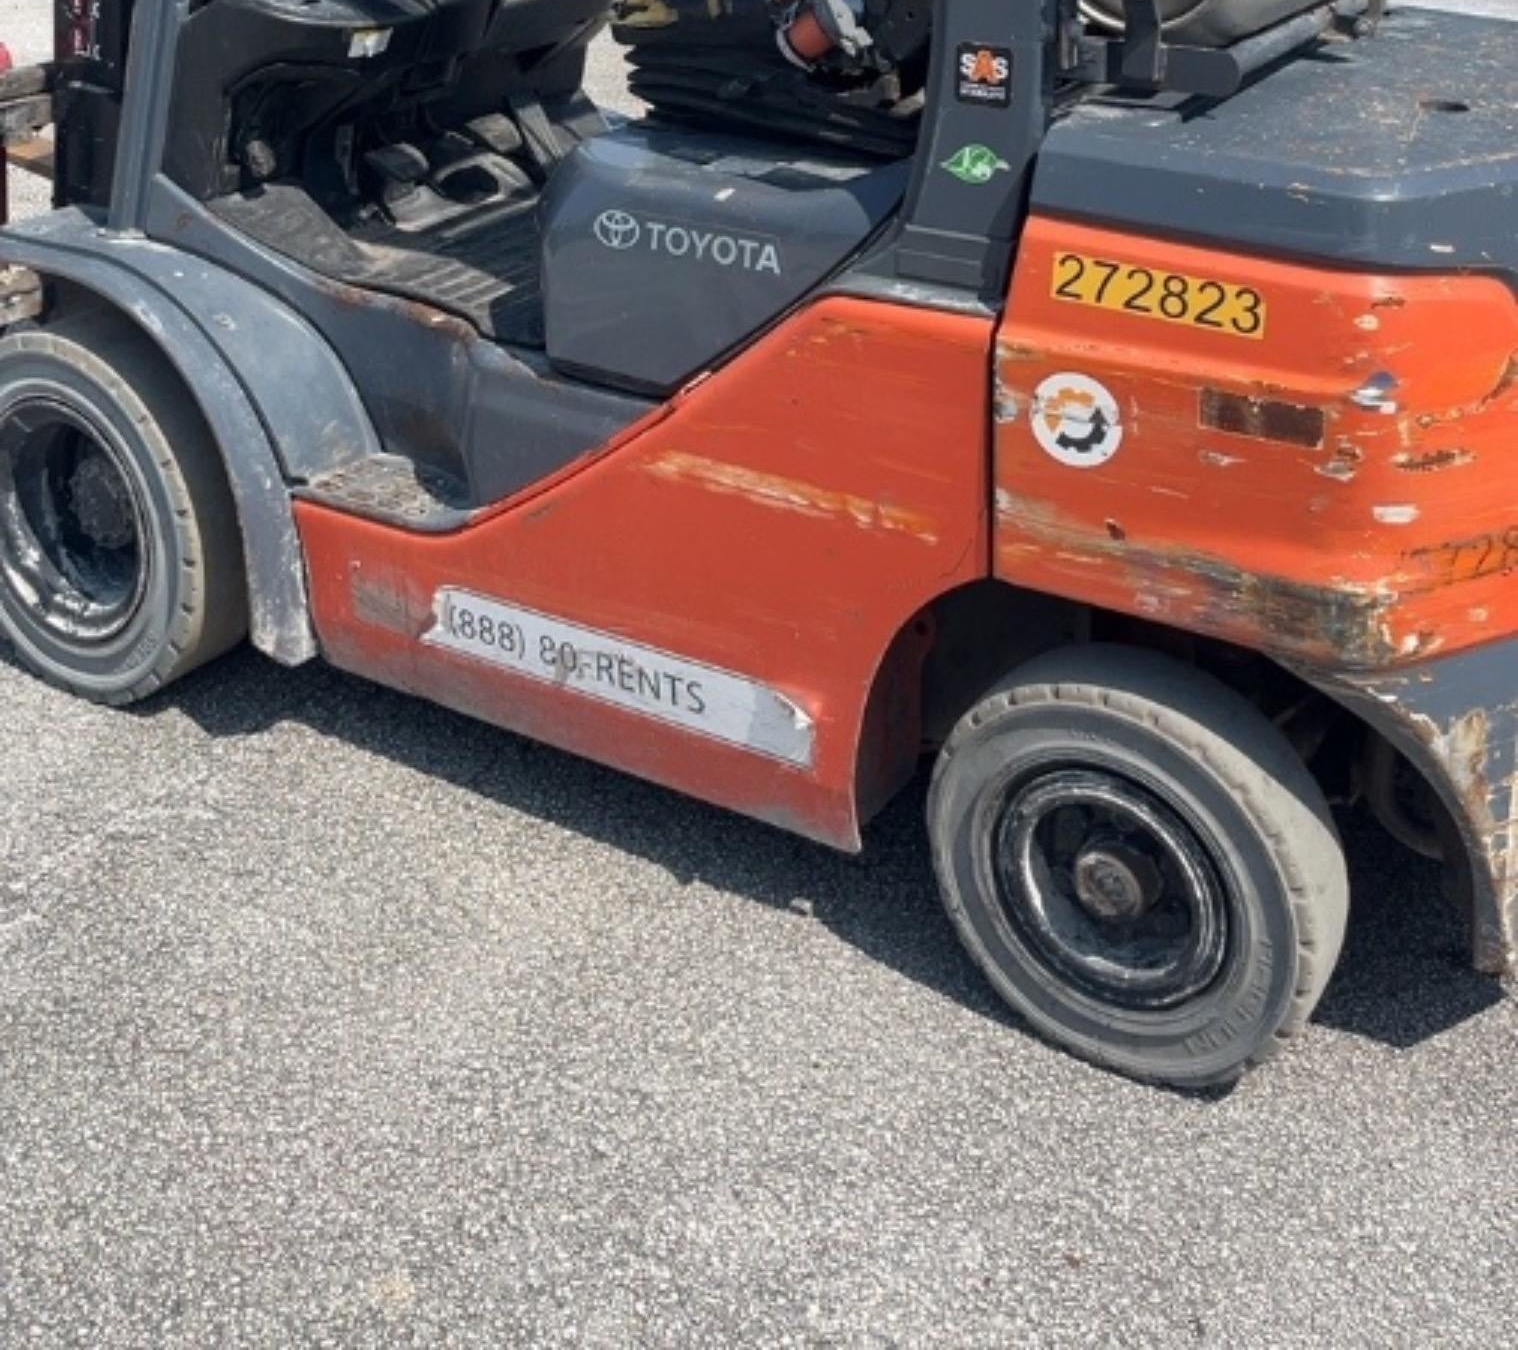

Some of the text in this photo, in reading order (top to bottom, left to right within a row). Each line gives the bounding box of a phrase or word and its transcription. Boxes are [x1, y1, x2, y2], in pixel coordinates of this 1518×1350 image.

[645, 221, 781, 276] TOYOTA
[1055, 254, 1262, 334] 272823
[449, 605, 526, 660] (888)
